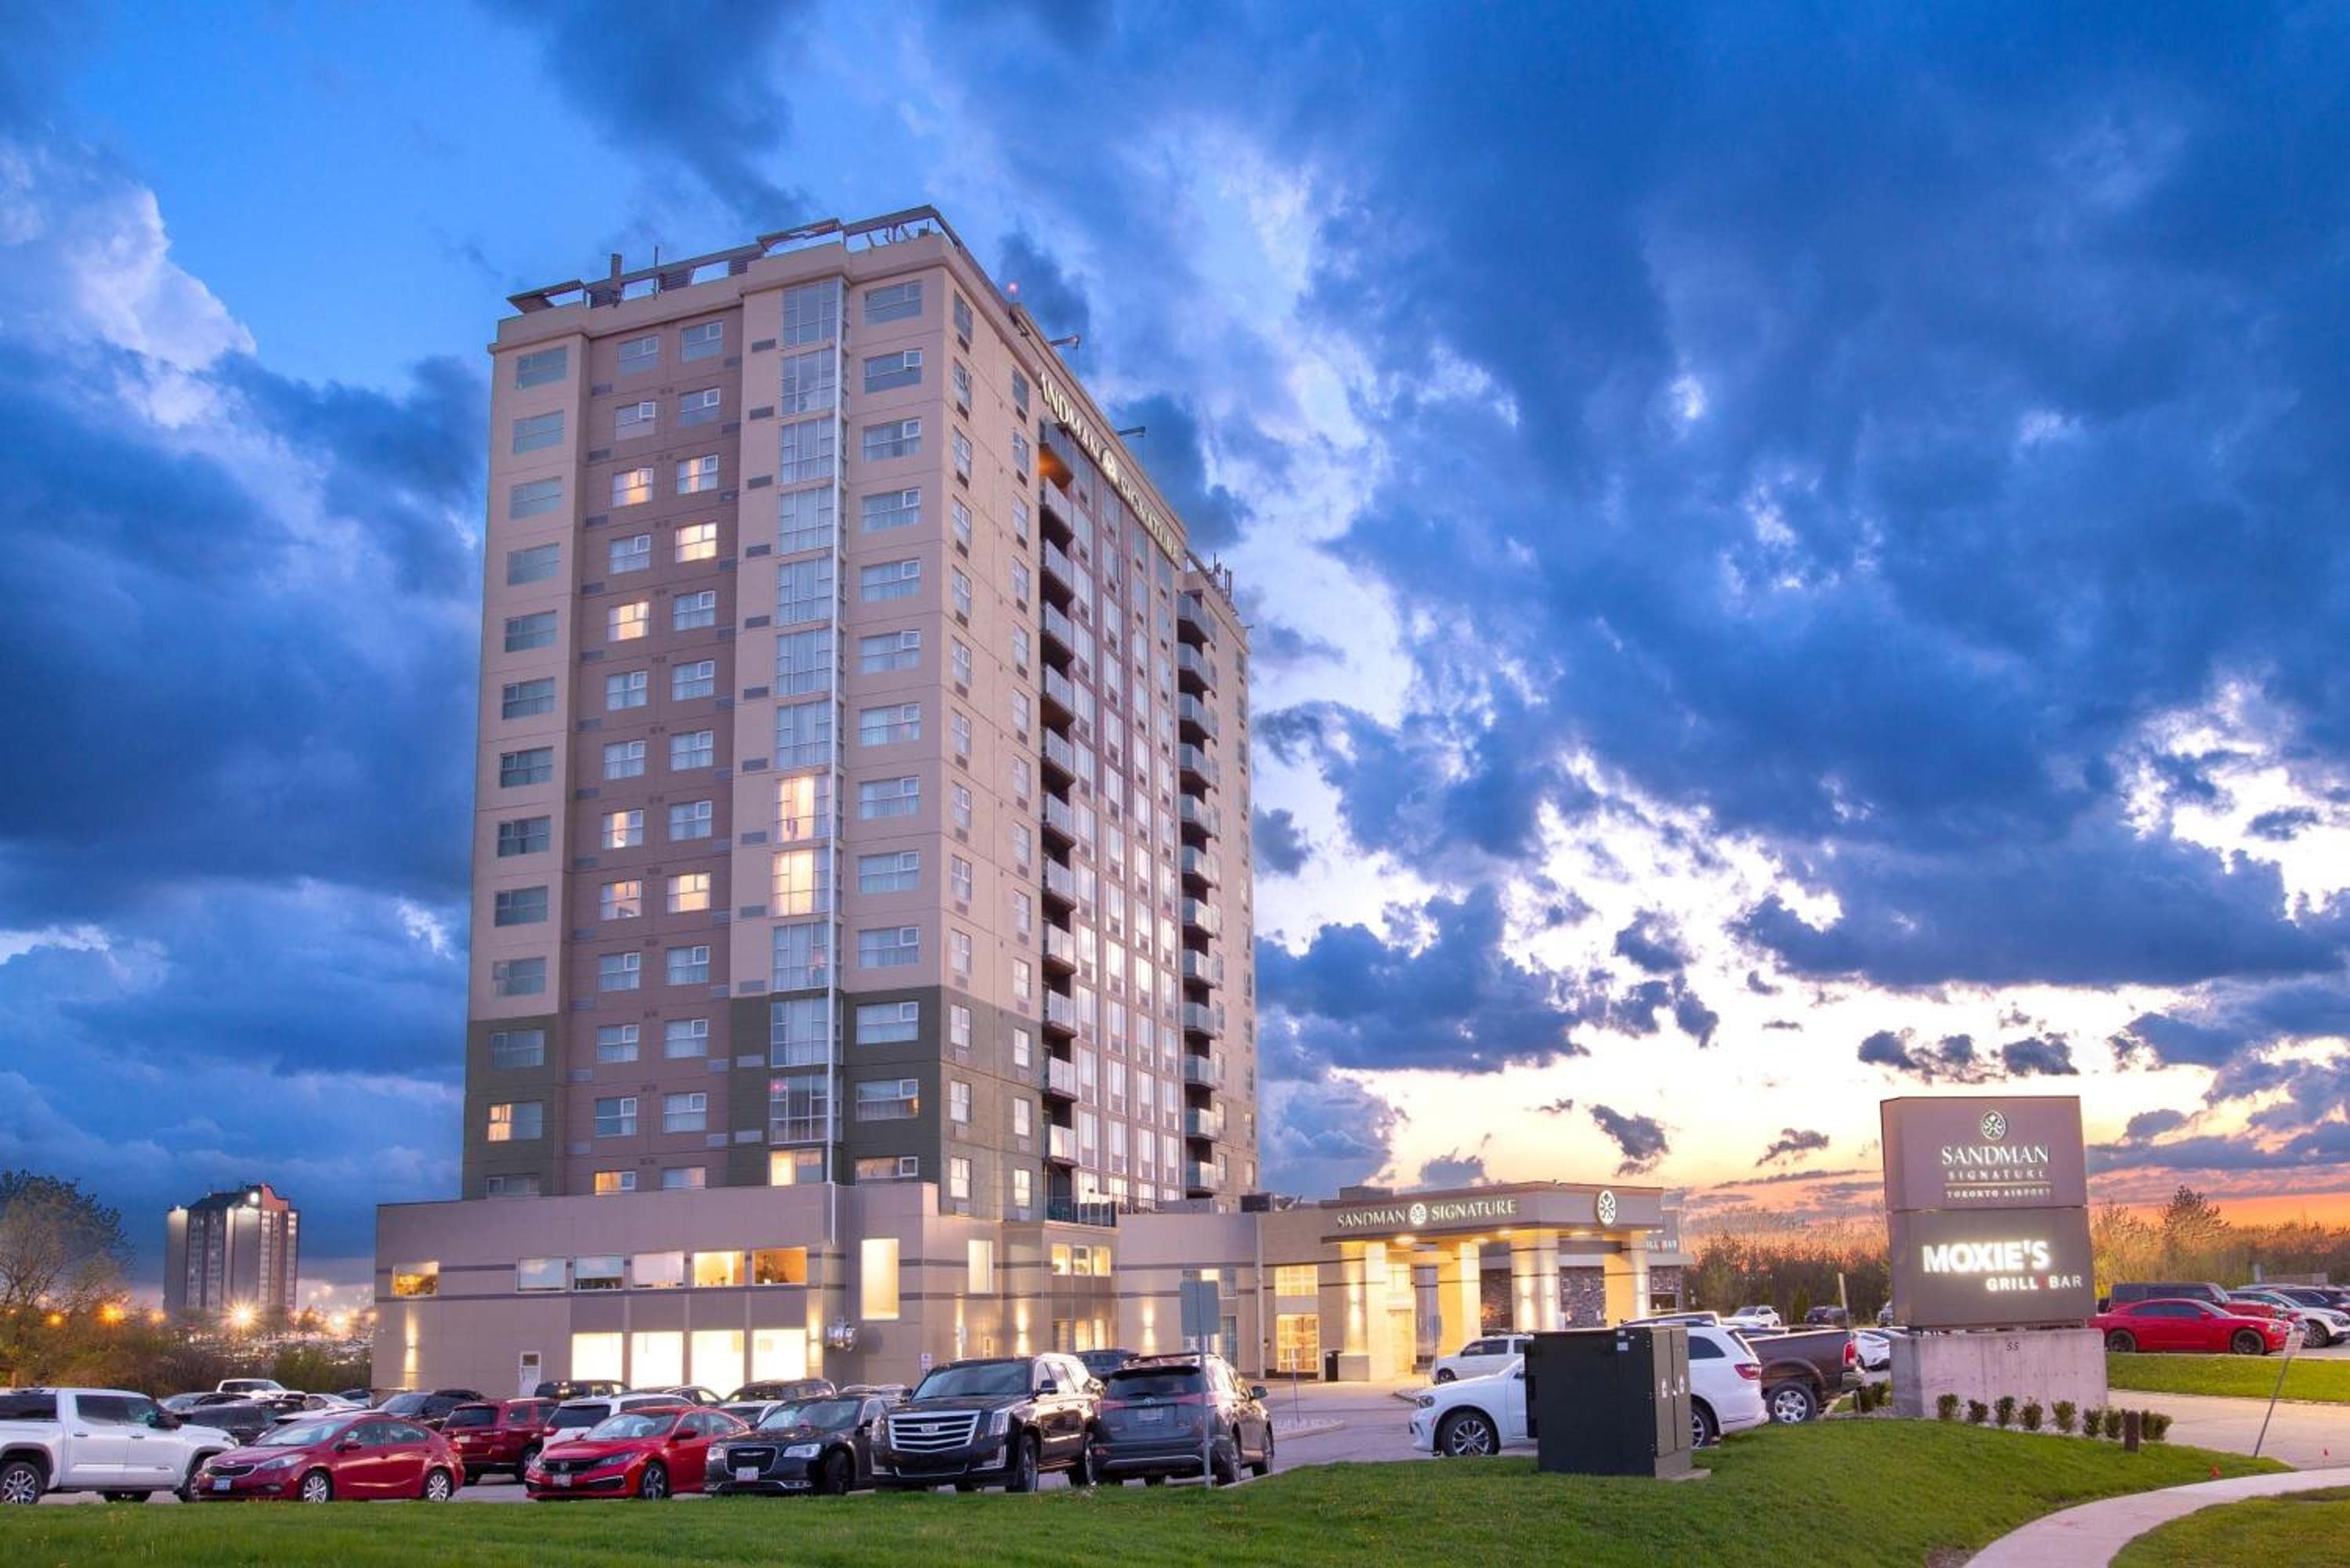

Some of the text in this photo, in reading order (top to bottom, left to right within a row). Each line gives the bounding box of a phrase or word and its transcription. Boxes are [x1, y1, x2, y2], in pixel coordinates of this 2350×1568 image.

[1941, 1145, 2049, 1165] SANDMAN
[1947, 1169, 2044, 1180] SIGNATURE
[1946, 1188, 2052, 1198] TORONTO AIRPORT
[1337, 1199, 1517, 1228] SANDMAN SIGNATURE
[1922, 1240, 2052, 1273] MOXIE'S
[1986, 1275, 2083, 1292] GRILL BAR
